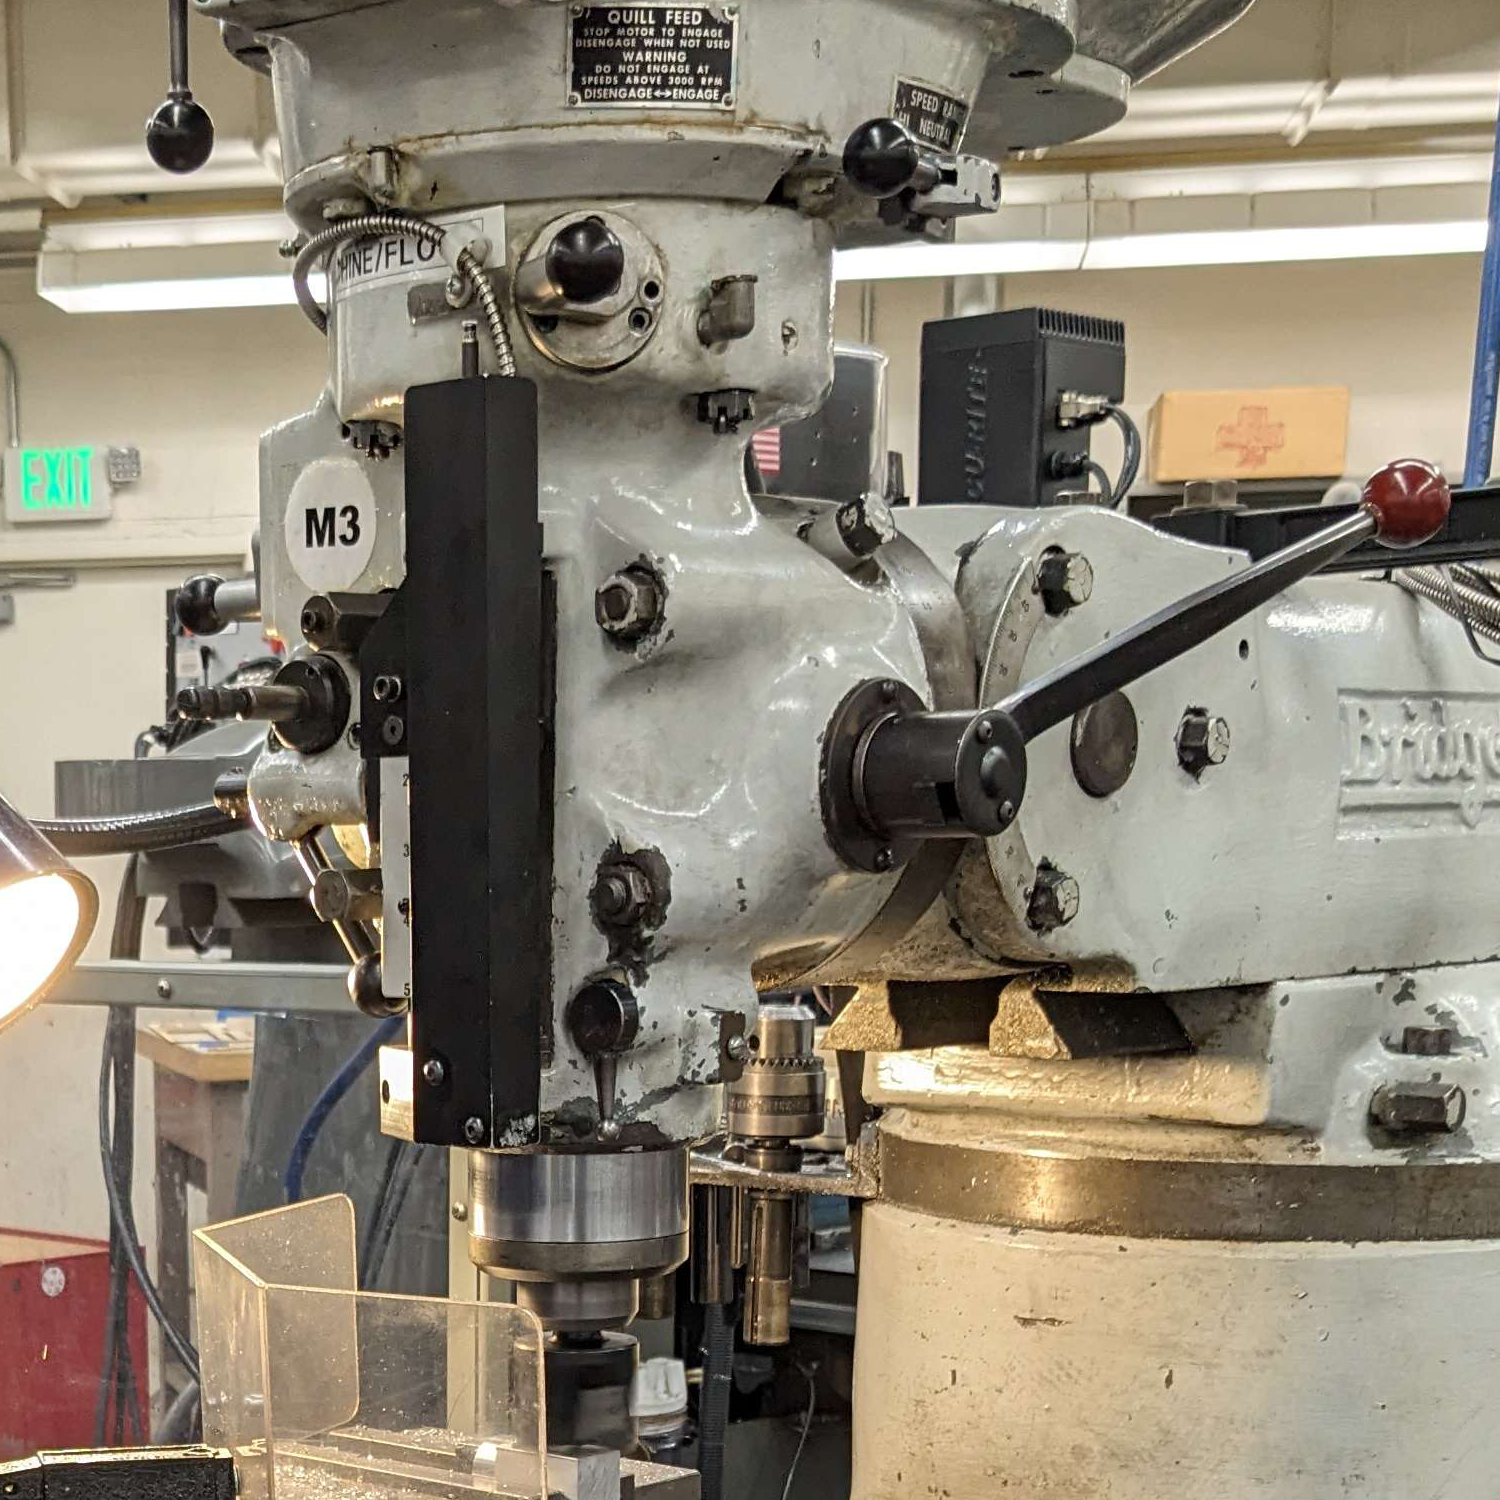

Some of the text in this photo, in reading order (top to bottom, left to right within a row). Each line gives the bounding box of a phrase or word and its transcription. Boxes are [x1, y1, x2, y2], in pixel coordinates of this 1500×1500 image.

[607, 10, 702, 25] QUILL FEED
[583, 27, 723, 38] STOP MOTOR TO ENGAGE
[575, 38, 731, 49] DISENGAGE WHEN NOT USED
[622, 51, 687, 63] WARNING
[595, 65, 710, 74] DO NOT ENGAGE AT
[581, 76, 723, 86] SPEEDS ABOVE 3000 RPM
[584, 88, 719, 100] DISENGAGE ENGAGE
[910, 89, 939, 113] SPEED
[337, 237, 437, 281] HINE/FLO
[963, 363, 988, 501] CU-RITE
[22, 445, 94, 509] EXIT
[305, 504, 361, 549] M3
[403, 843, 410, 857] 3
[403, 983, 411, 997] 5
